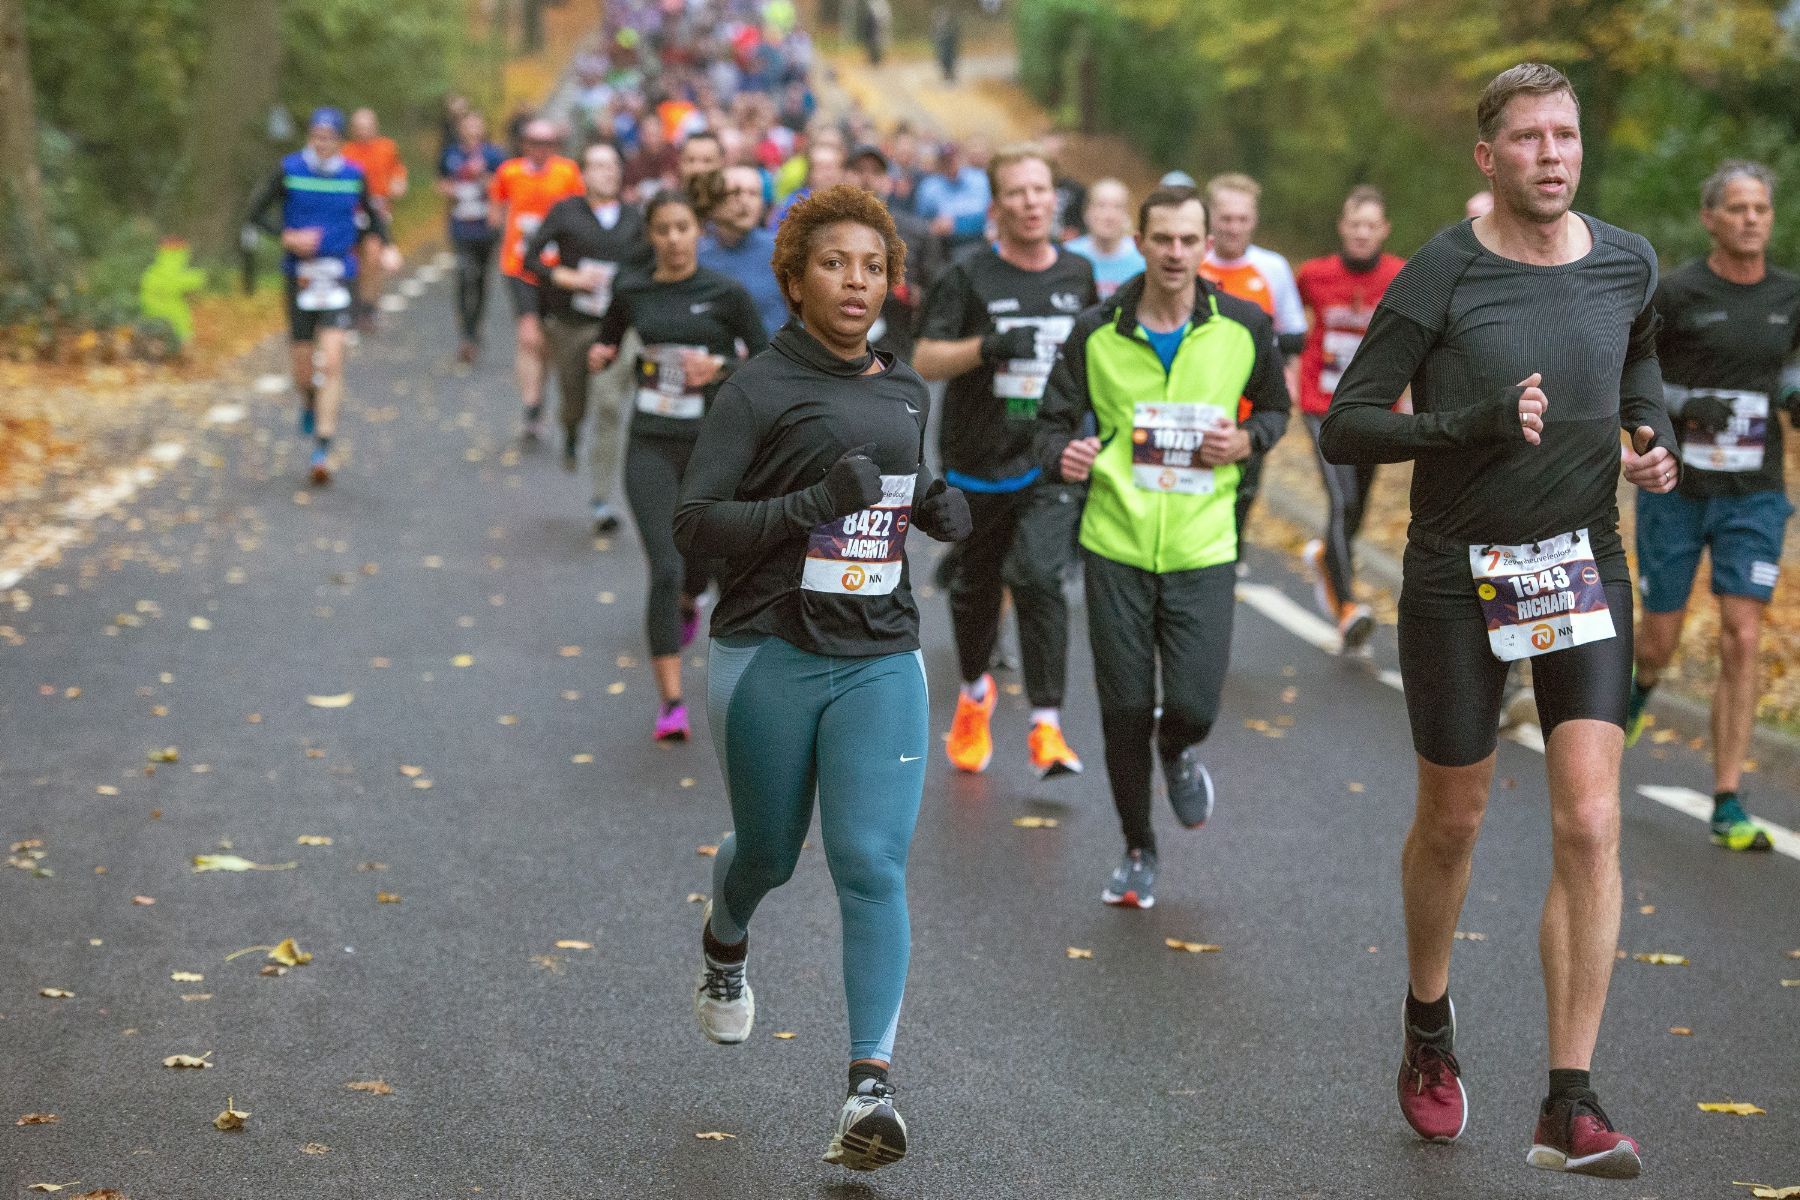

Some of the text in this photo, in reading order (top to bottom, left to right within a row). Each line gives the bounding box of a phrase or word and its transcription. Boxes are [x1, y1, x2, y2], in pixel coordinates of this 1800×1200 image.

[842, 510, 893, 537] 8422
[841, 538, 889, 559] JACINTA
[1503, 548, 1572, 566] Zevenheuvelenloo
[1487, 550, 1501, 571] 7
[869, 574, 882, 583] NN
[1508, 565, 1570, 598] 1543
[1517, 590, 1576, 620] RICHARD
[1558, 625, 1574, 637] NN
